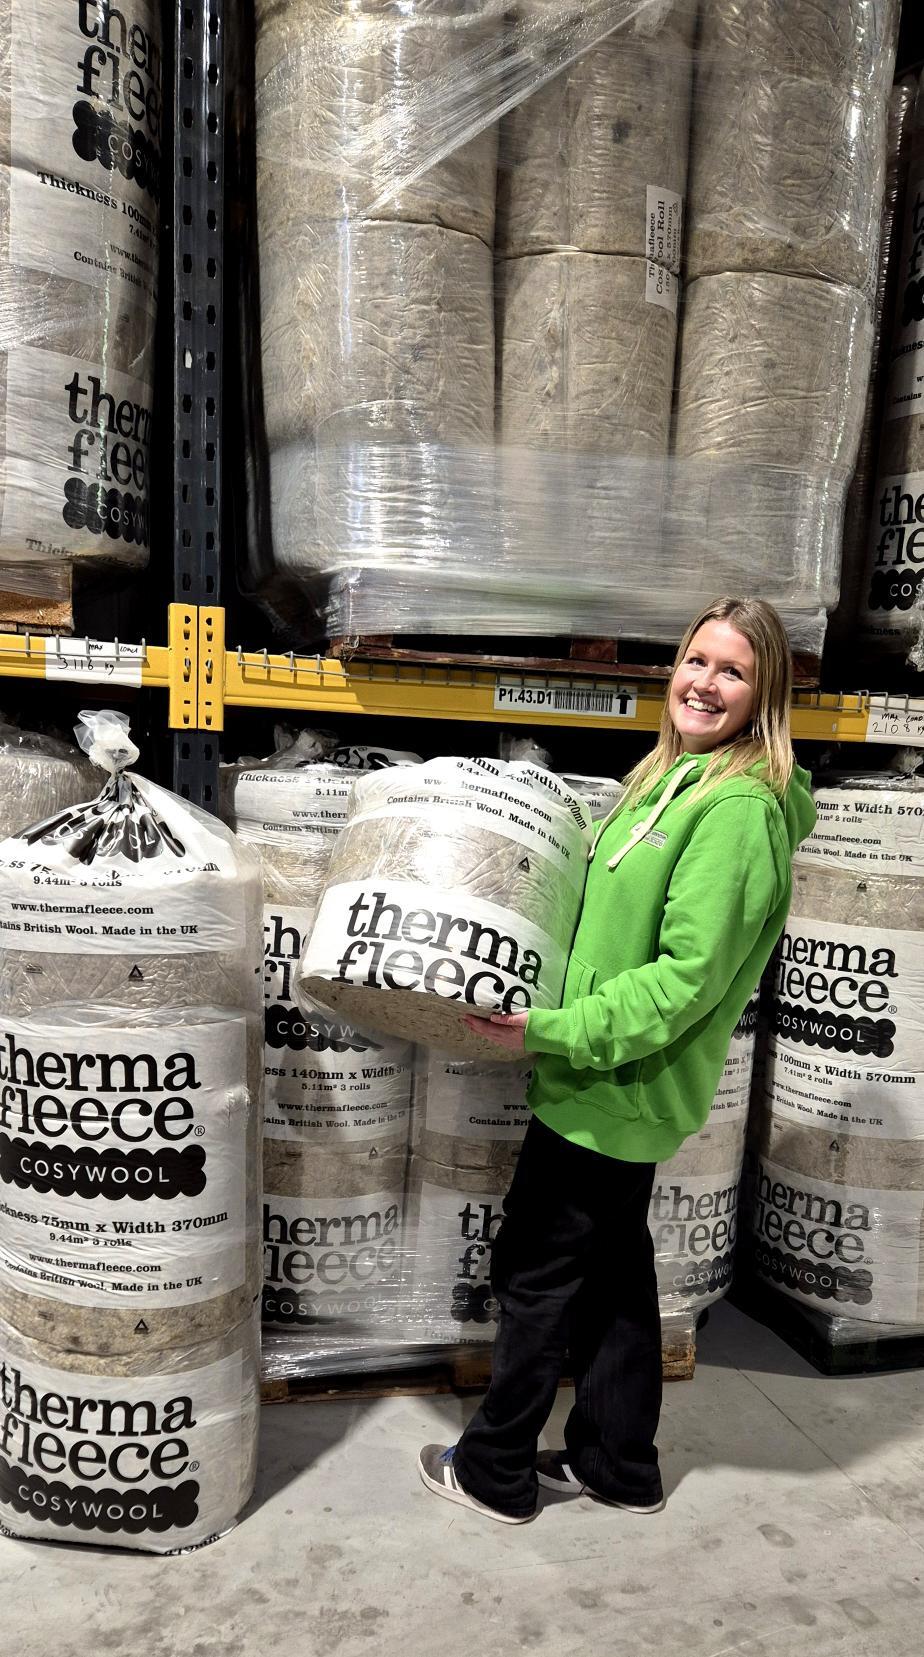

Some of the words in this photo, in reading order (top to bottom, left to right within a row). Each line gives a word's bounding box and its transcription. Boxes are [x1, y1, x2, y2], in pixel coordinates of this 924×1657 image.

[37, 171, 118, 209] Thickness
[657, 200, 665, 232] Roll
[57, 657, 94, 670] 3116
[498, 688, 552, 705] P1.43.D1
[872, 720, 911, 735] 2108
[562, 793, 588, 831] 370mm
[842, 804, 851, 812] x
[854, 802, 893, 815] Width
[842, 815, 863, 824] rolls
[476, 802, 505, 818] Wool.
[508, 812, 536, 832] Made
[537, 826, 546, 839] in
[548, 835, 561, 850] the
[561, 847, 572, 860] UK
[823, 848, 843, 860] Wool.
[844, 849, 867, 860] Made
[869, 852, 879, 861] in
[881, 853, 896, 862] the
[898, 854, 913, 863] UK
[11, 902, 155, 916] www.thermafleece.com
[23, 921, 62, 935] British
[65, 925, 98, 935] Wool.
[102, 925, 136, 935] Made
[139, 925, 153, 935] in
[156, 924, 178, 935] the
[181, 924, 200, 935] UK
[345, 892, 545, 991] therma
[290, 1066, 345, 1080] 140mm
[347, 1071, 358, 1080] x
[361, 1063, 394, 1079] Width
[779, 1053, 811, 1072] 100mm
[813, 1063, 821, 1074] x
[824, 1064, 862, 1081] Width
[865, 1072, 917, 1085] 570mm
[340, 1083, 347, 1091] 3
[349, 1081, 371, 1092] rolls
[814, 1076, 833, 1087] rolls
[277, 1101, 389, 1113] www.thermafleece.com
[288, 1119, 323, 1129] British
[325, 1120, 351, 1129] Wool.
[353, 1118, 376, 1128] Made
[469, 1115, 512, 1126] Contains
[816, 1108, 838, 1121] Made
[839, 1112, 849, 1122] in
[851, 1115, 867, 1125] the
[869, 1117, 884, 1127] UK
[20, 1157, 171, 1184] COSYWOOL
[41, 1214, 91, 1233] 75mm
[95, 1224, 107, 1234] x
[112, 1219, 166, 1234] Width
[171, 1210, 229, 1232] 370mm
[28, 1253, 163, 1274] www.thermafleece.com
[111, 1281, 144, 1292] Made
[146, 1281, 160, 1292] in
[162, 1279, 183, 1291] the
[185, 1275, 203, 1288] UK
[0, 1361, 197, 1437] therma
[18, 1484, 164, 1520] COSYWOOL
